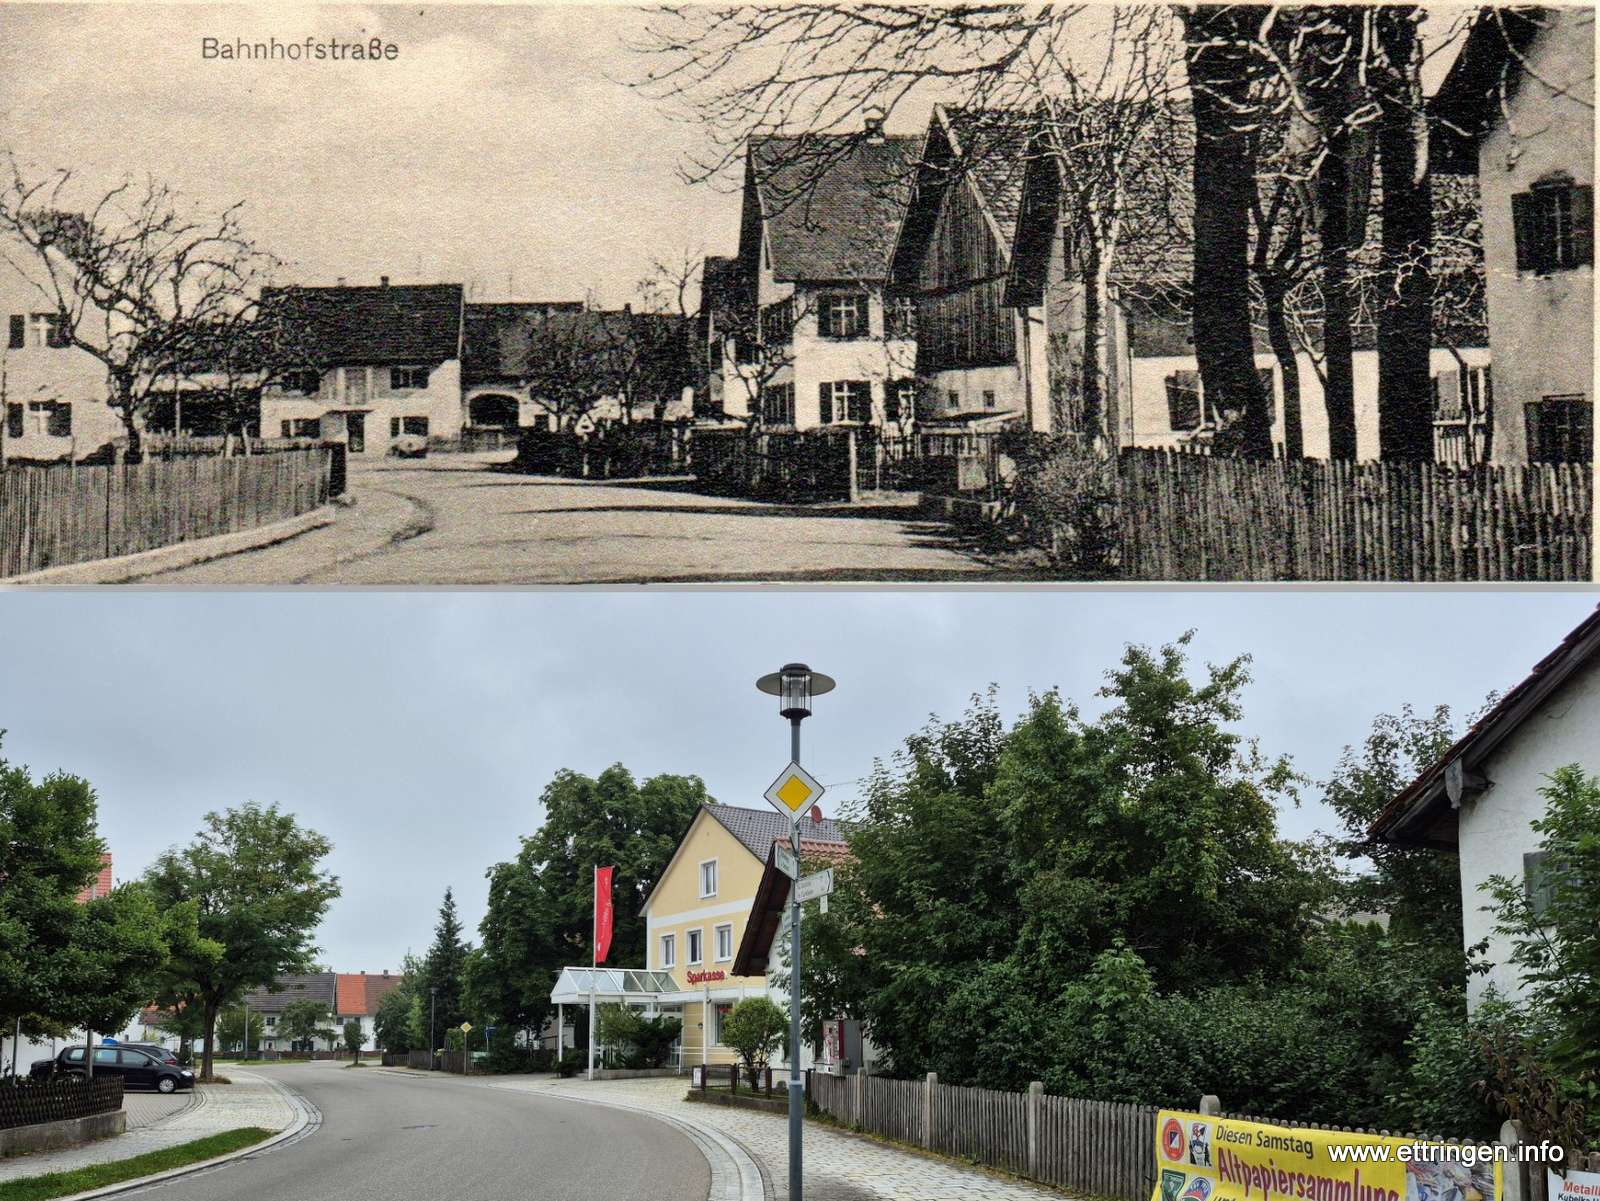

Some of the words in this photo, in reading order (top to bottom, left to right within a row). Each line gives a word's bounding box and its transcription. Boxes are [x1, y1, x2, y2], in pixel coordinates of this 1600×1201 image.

[686, 969, 726, 985] Sparkasse
[1216, 1124, 1252, 1145] Diesen
[1256, 1130, 1314, 1160] Samstag
